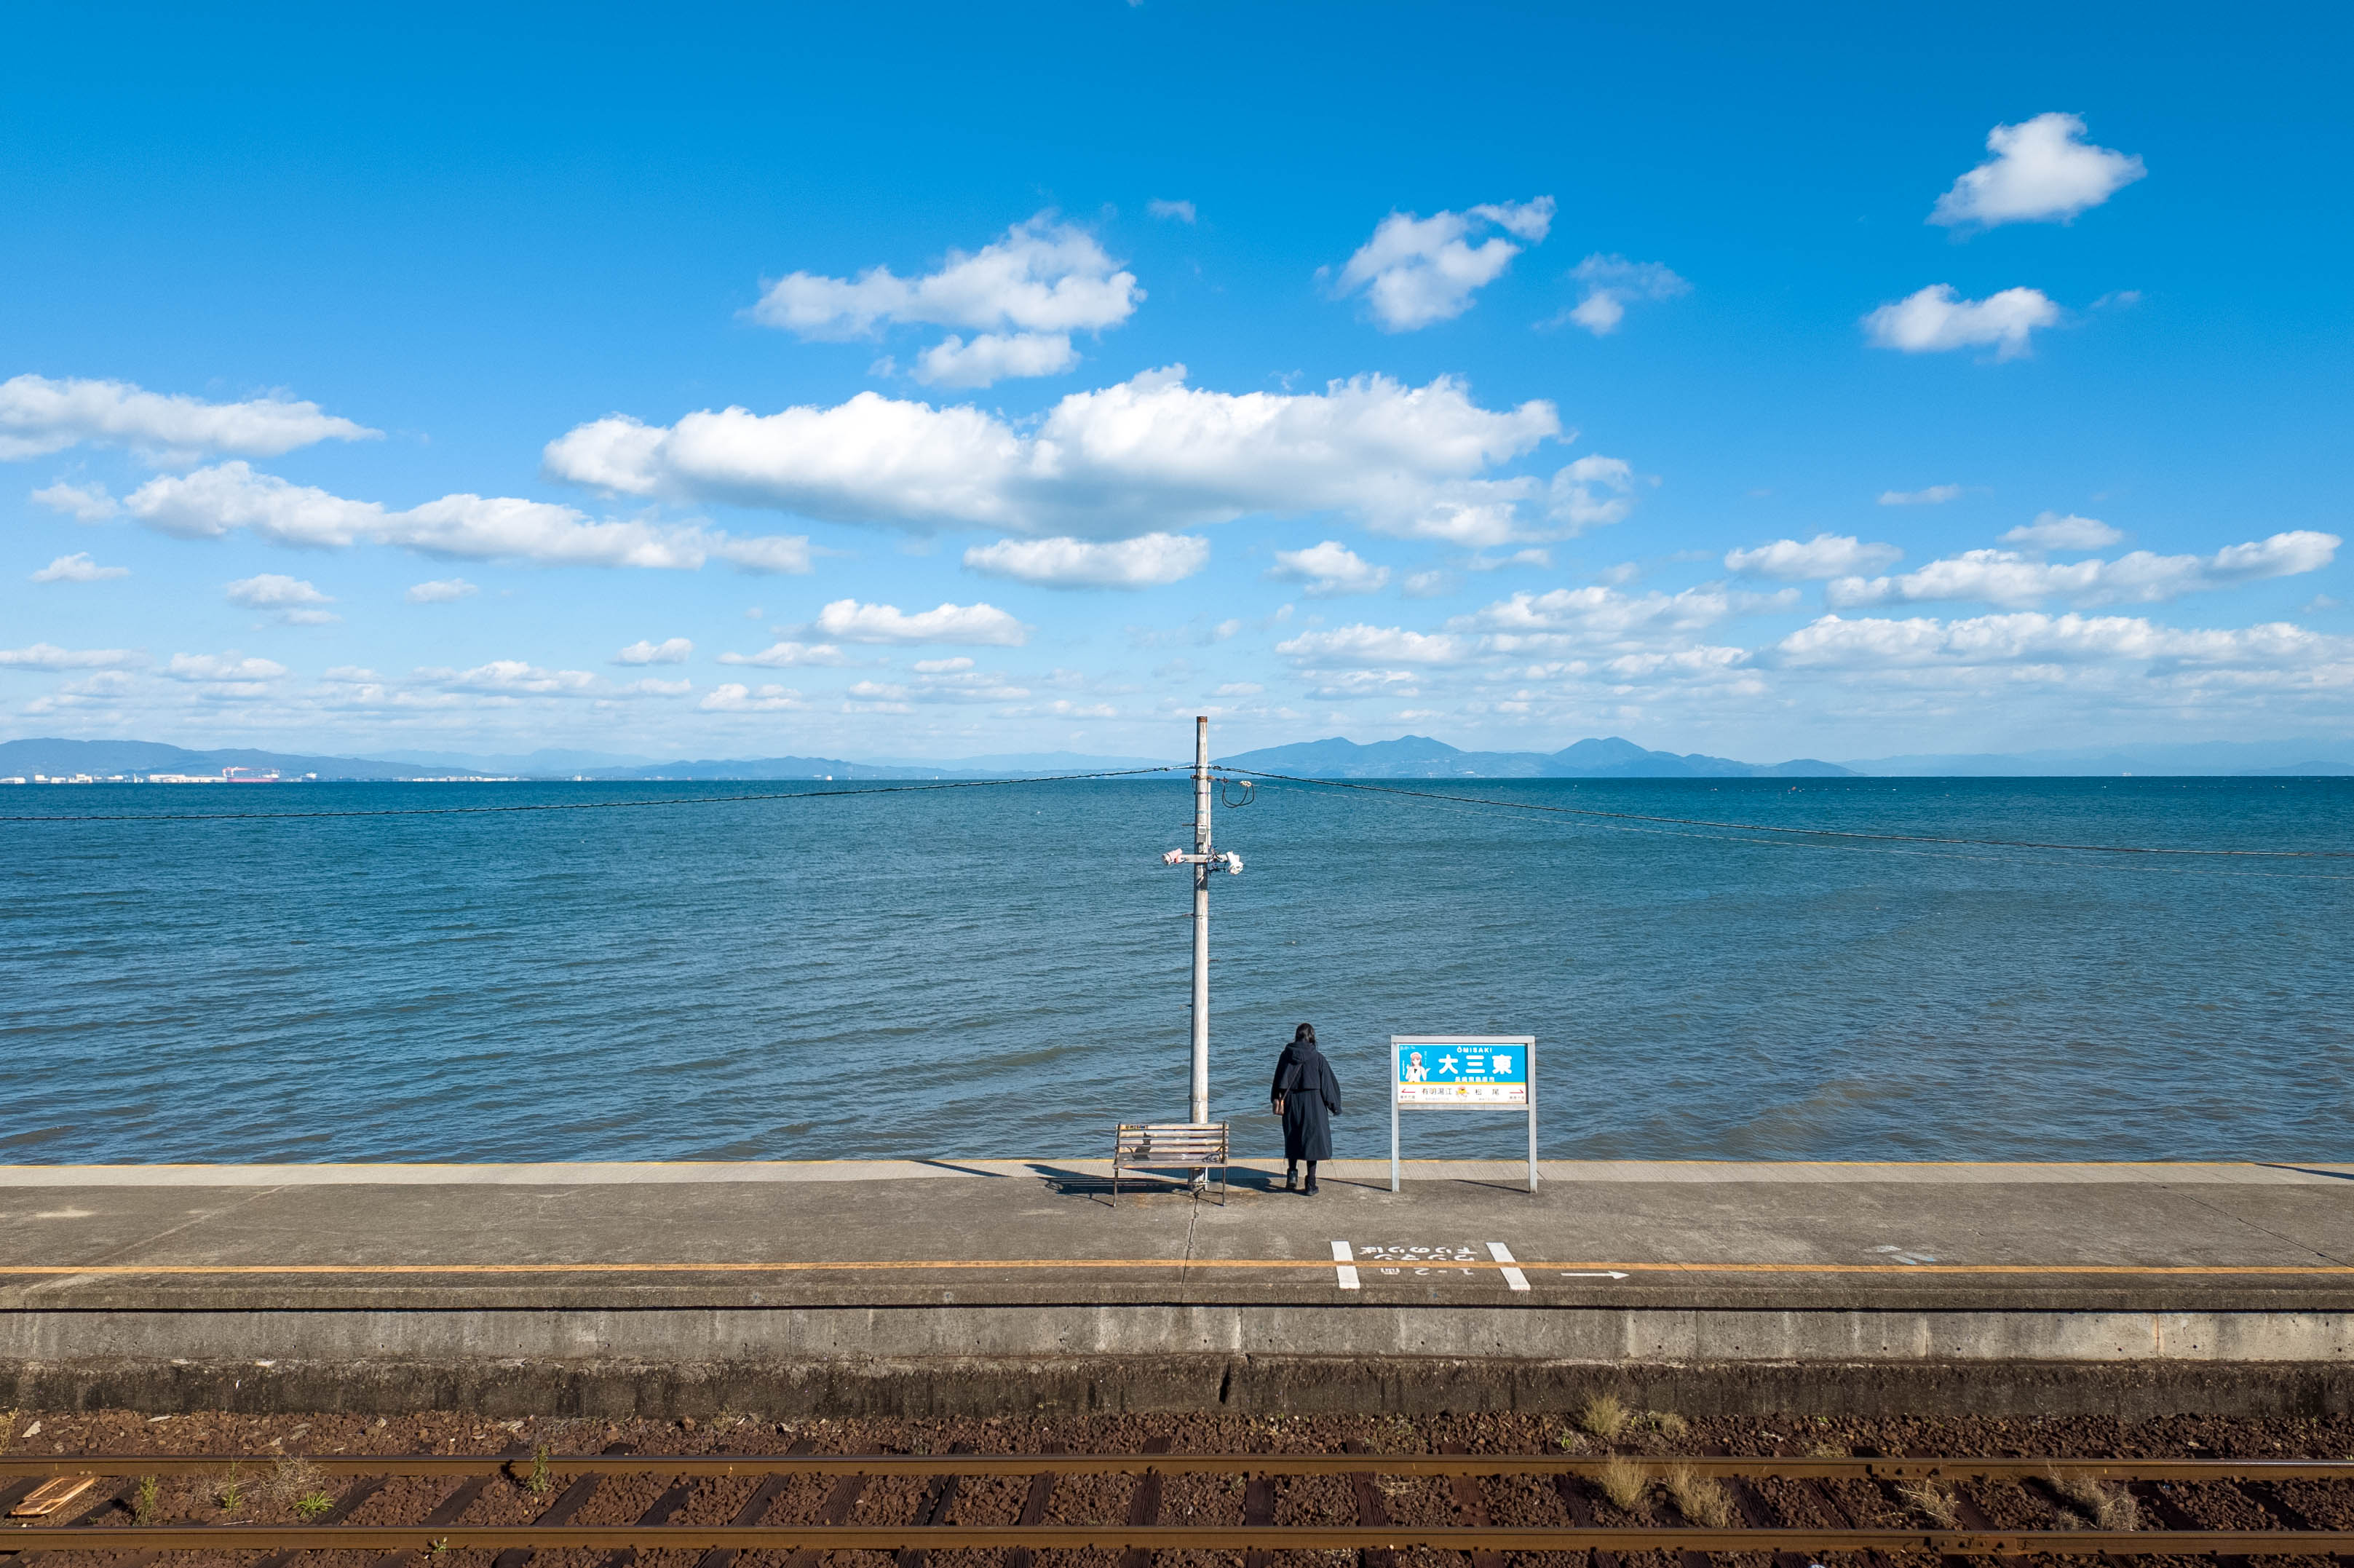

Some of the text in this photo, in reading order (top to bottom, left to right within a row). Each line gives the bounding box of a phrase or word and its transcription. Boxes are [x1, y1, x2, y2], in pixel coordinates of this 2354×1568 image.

[1438, 1054, 1513, 1074] 大三東
[1374, 1254, 1475, 1262] ワンマン
